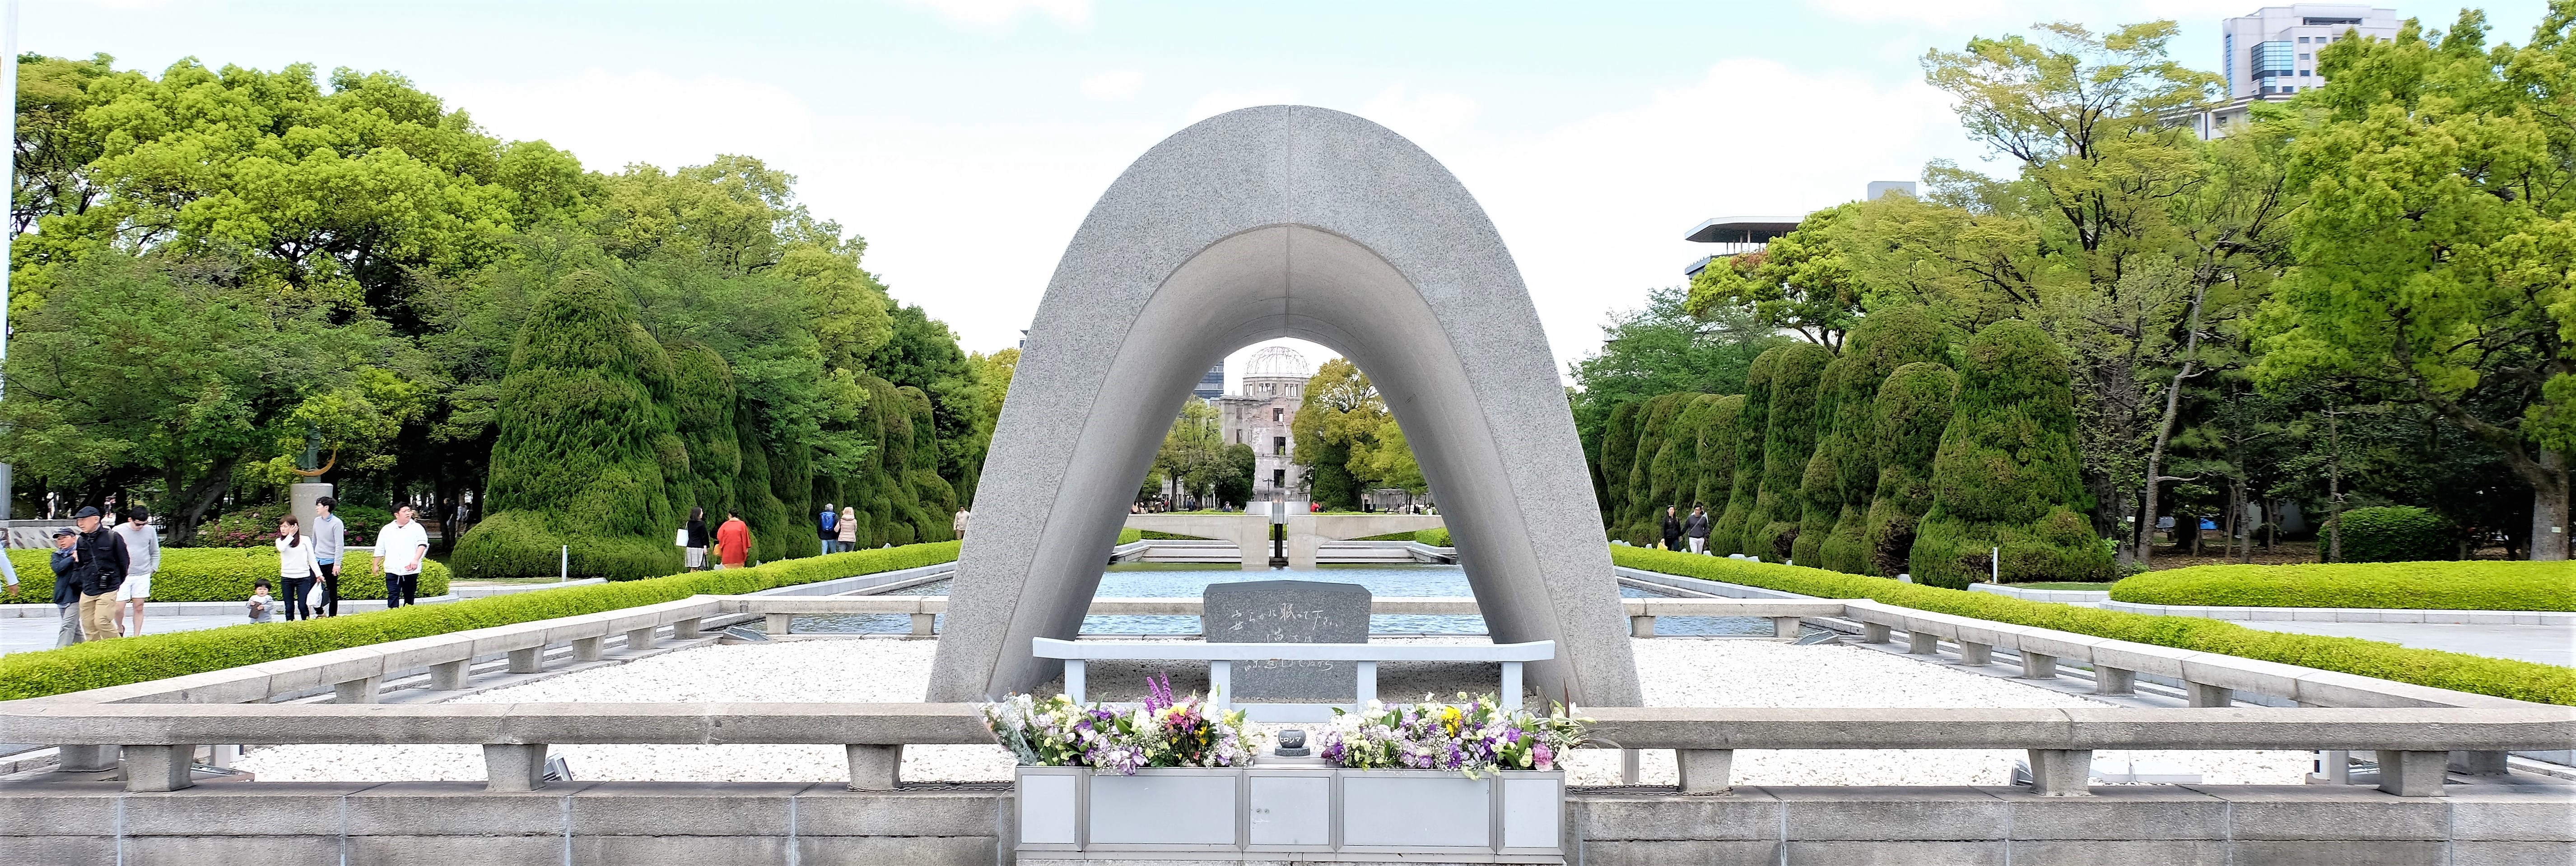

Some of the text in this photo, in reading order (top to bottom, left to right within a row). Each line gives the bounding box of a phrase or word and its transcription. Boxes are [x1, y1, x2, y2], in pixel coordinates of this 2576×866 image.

[1228, 602, 1338, 631] 安らかに眠って下さい
[1279, 735, 1301, 744] ヒロシマ
